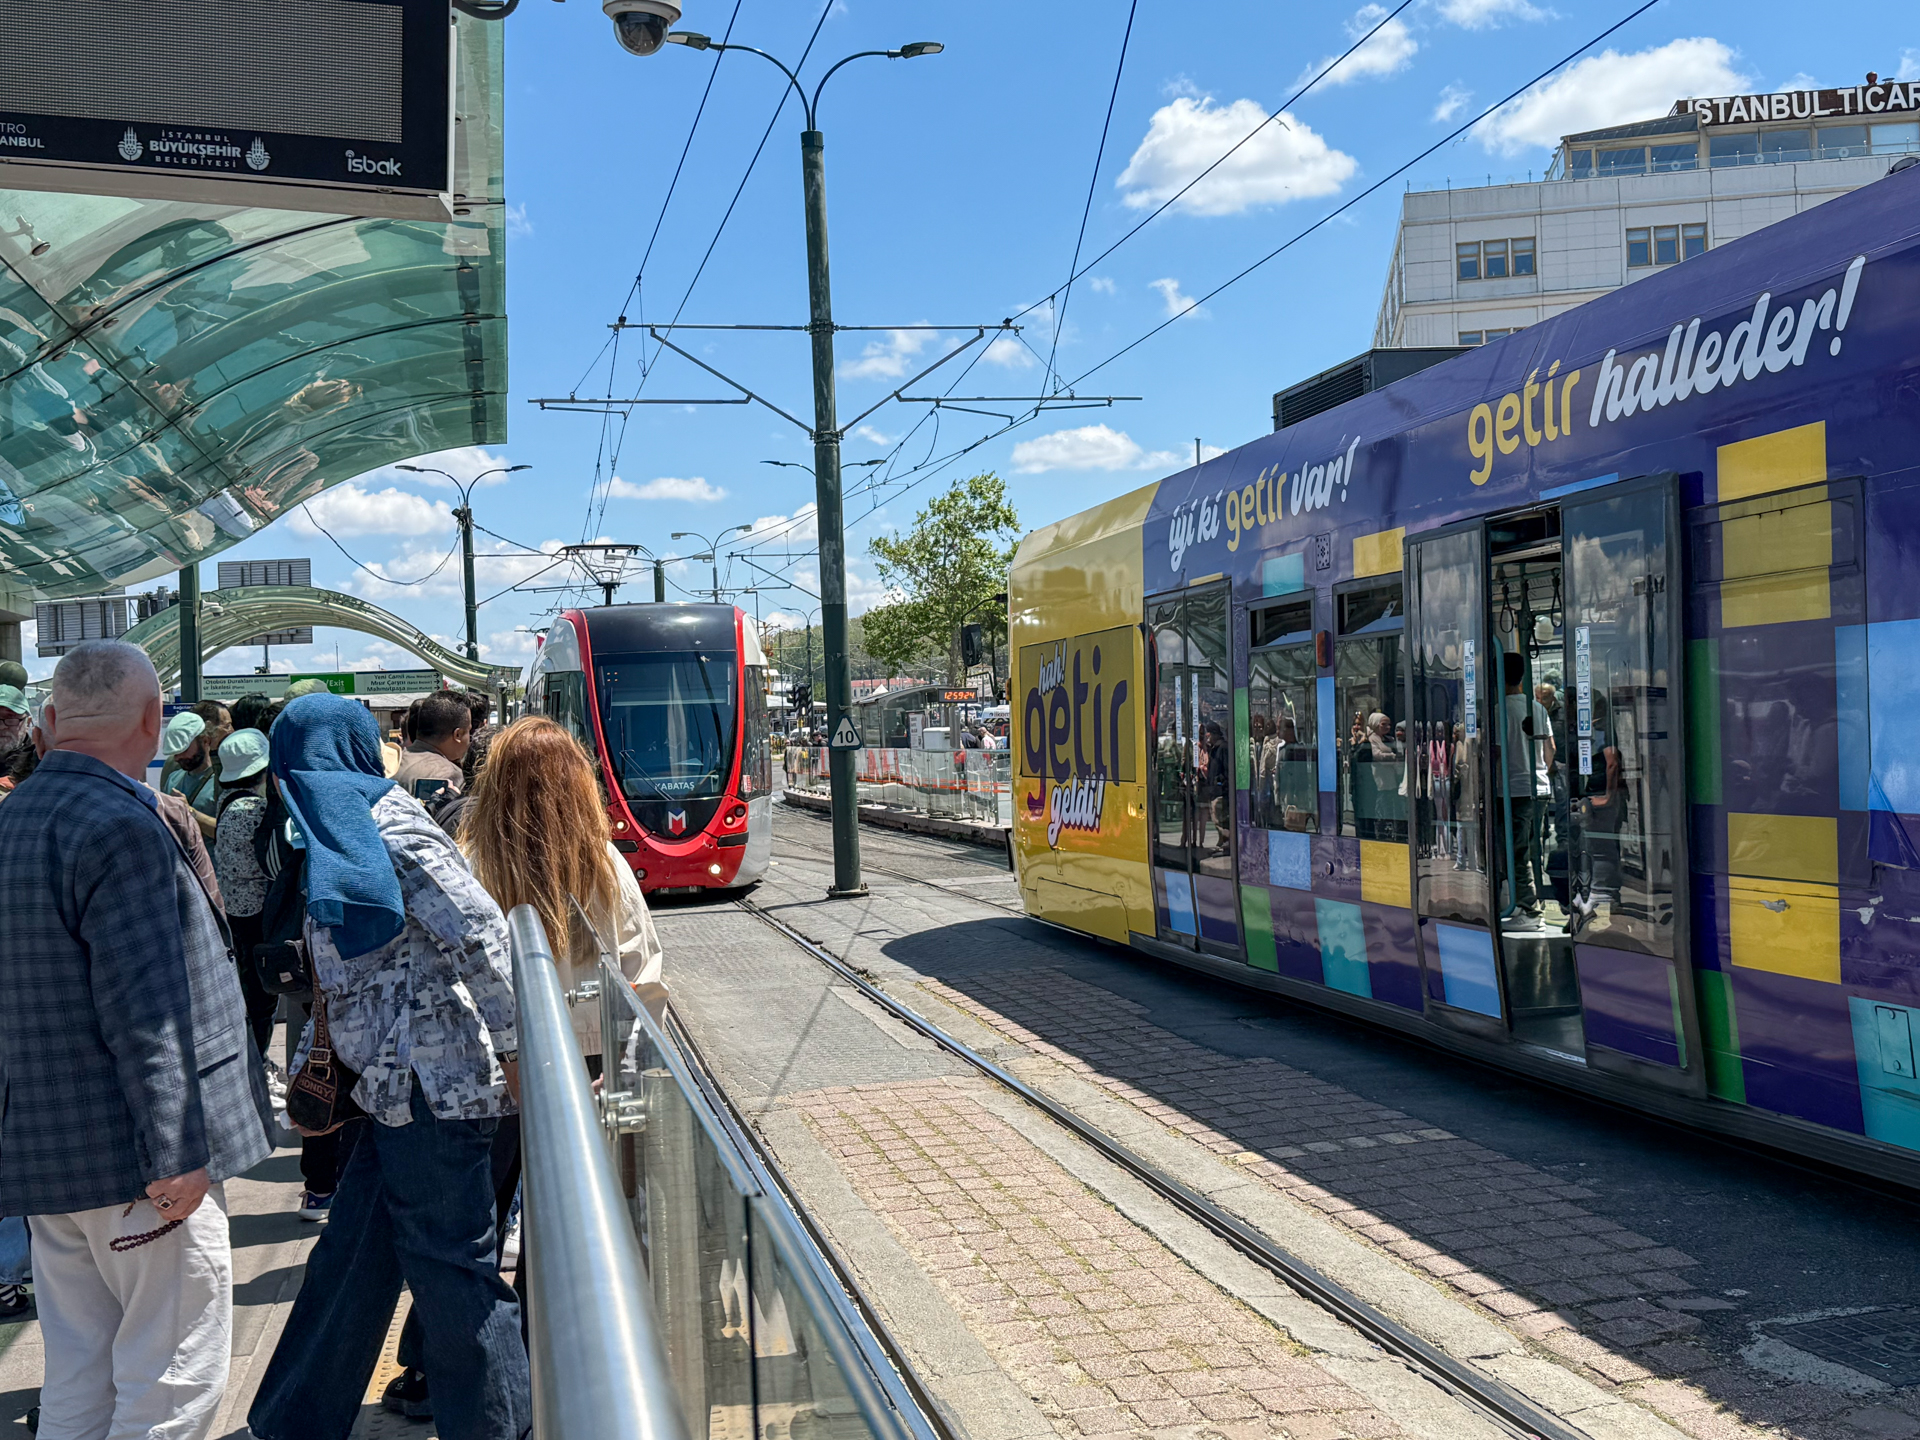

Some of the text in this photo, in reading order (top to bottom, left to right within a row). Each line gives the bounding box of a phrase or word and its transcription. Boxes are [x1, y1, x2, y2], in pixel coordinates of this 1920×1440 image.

[149, 138, 241, 159] BÜYÜKŞEHİR
[155, 155, 236, 168] BELEDİYESİ
[161, 129, 230, 142] İSTANBUL
[1467, 255, 1867, 486] getir halleder!
[1197, 489, 1224, 544] ki
[1225, 462, 1287, 552] getir
[1290, 435, 1361, 516] var!
[1037, 637, 1067, 696] hah!
[837, 730, 854, 744] 10
[1024, 644, 1128, 817] getir
[1046, 772, 1106, 850] geldi!
